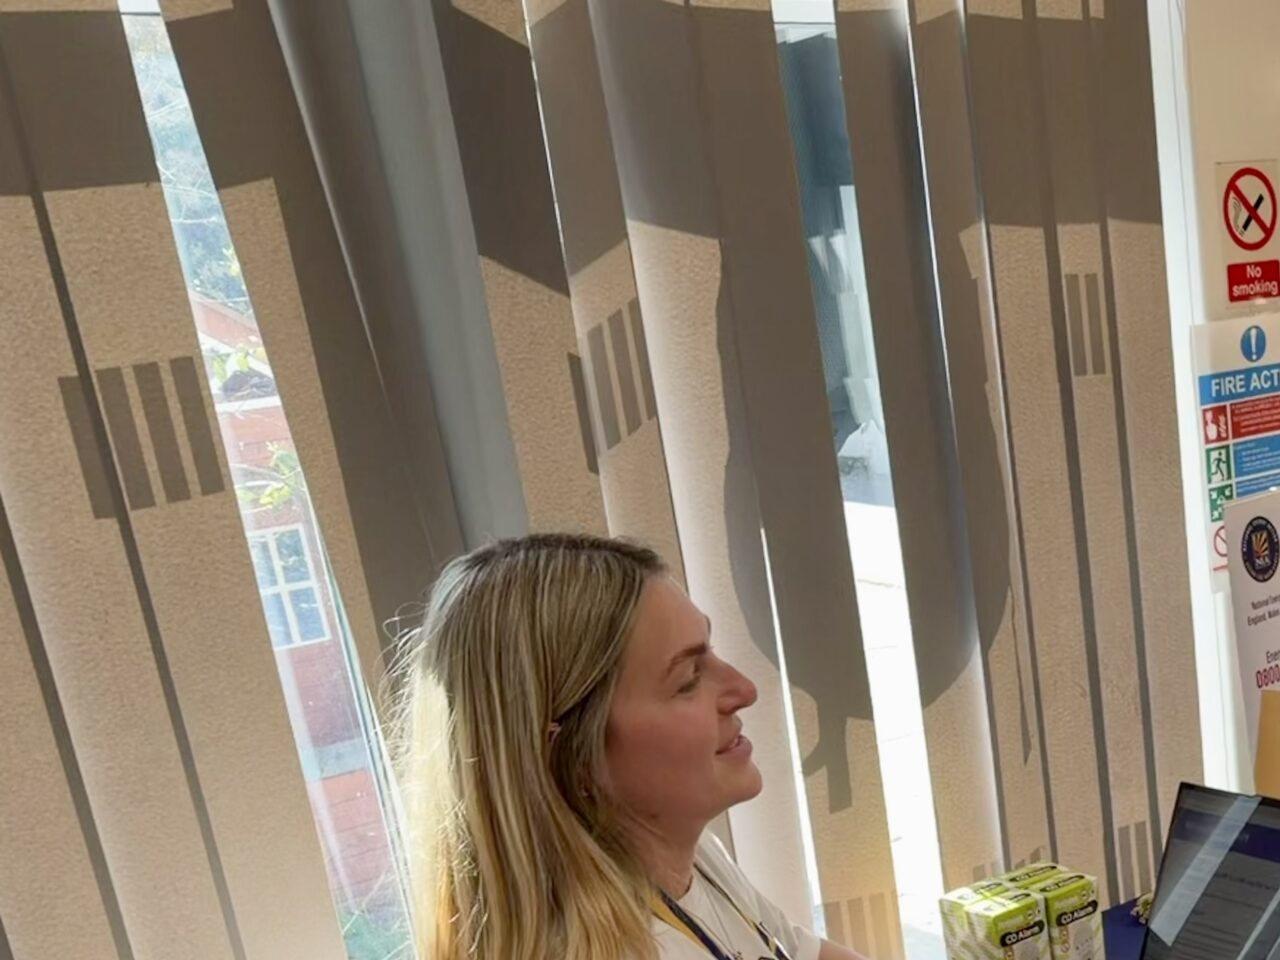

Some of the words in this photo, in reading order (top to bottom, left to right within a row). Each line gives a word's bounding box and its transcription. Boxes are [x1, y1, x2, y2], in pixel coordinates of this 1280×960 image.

[1246, 264, 1262, 278] No
[1232, 280, 1278, 297] smoking
[1211, 374, 1247, 397] FIRE
[1256, 663, 1280, 689] 0800
[1060, 912, 1072, 924] CO
[1004, 933, 1018, 945] CO
